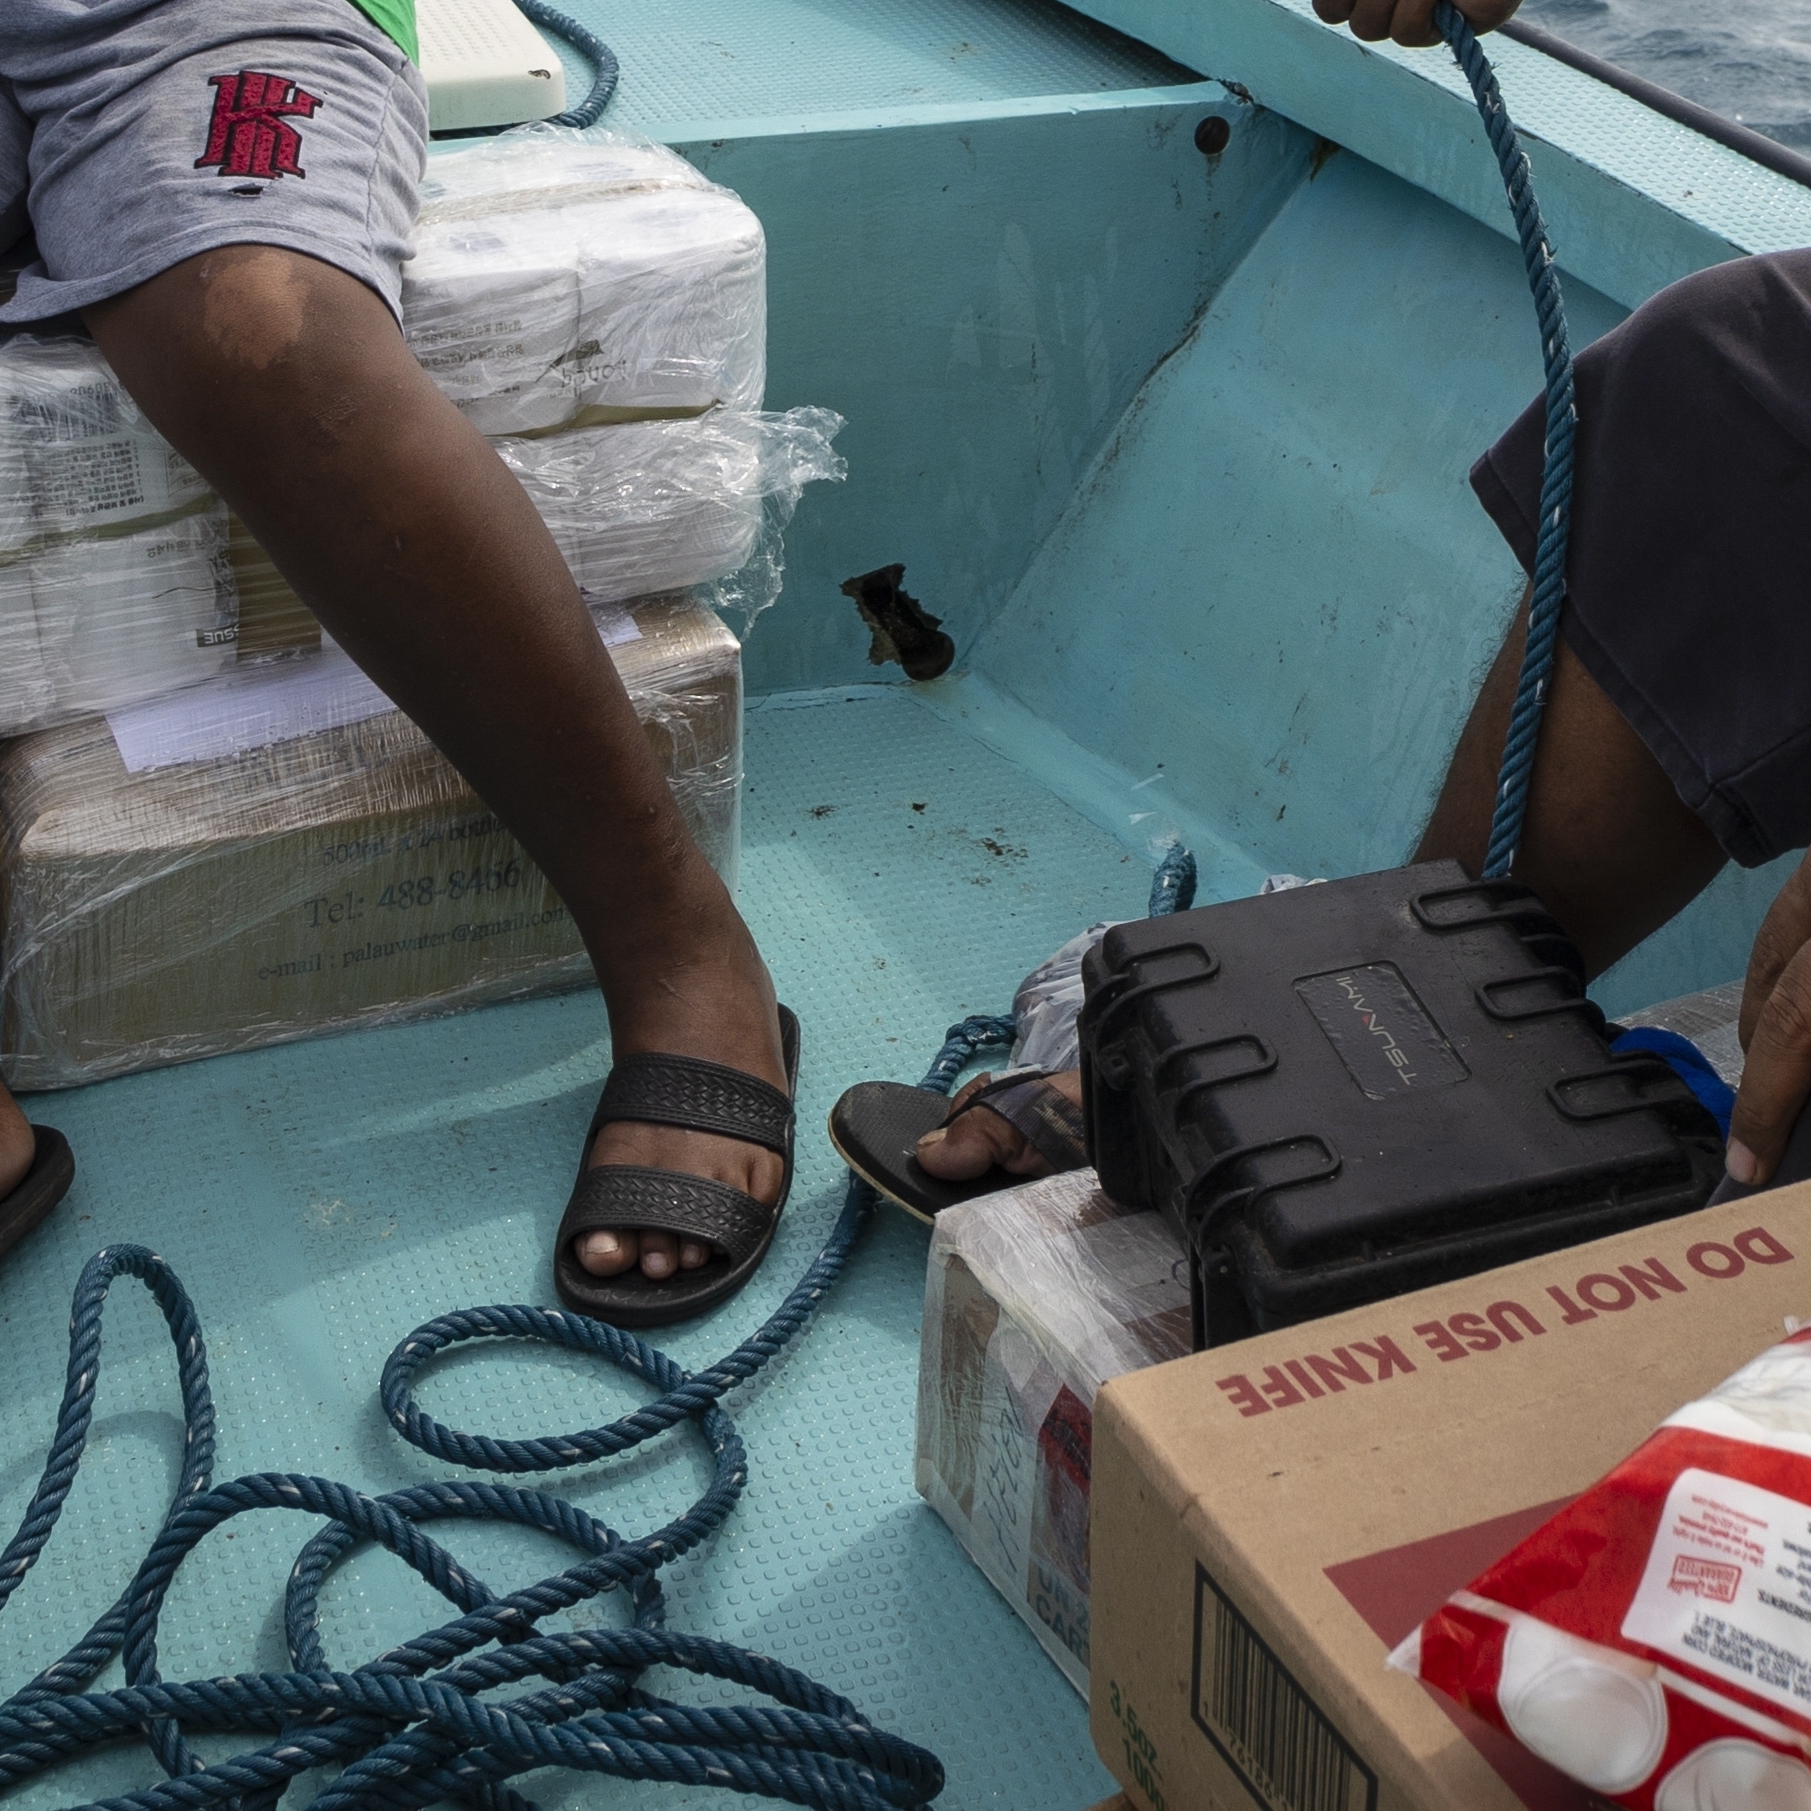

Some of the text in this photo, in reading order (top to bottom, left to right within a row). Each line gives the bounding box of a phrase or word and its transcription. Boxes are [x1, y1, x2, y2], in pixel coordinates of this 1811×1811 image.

[303, 892, 365, 929] Tel:
[1214, 1226, 1795, 1418] DO NOT USE KNIFE
